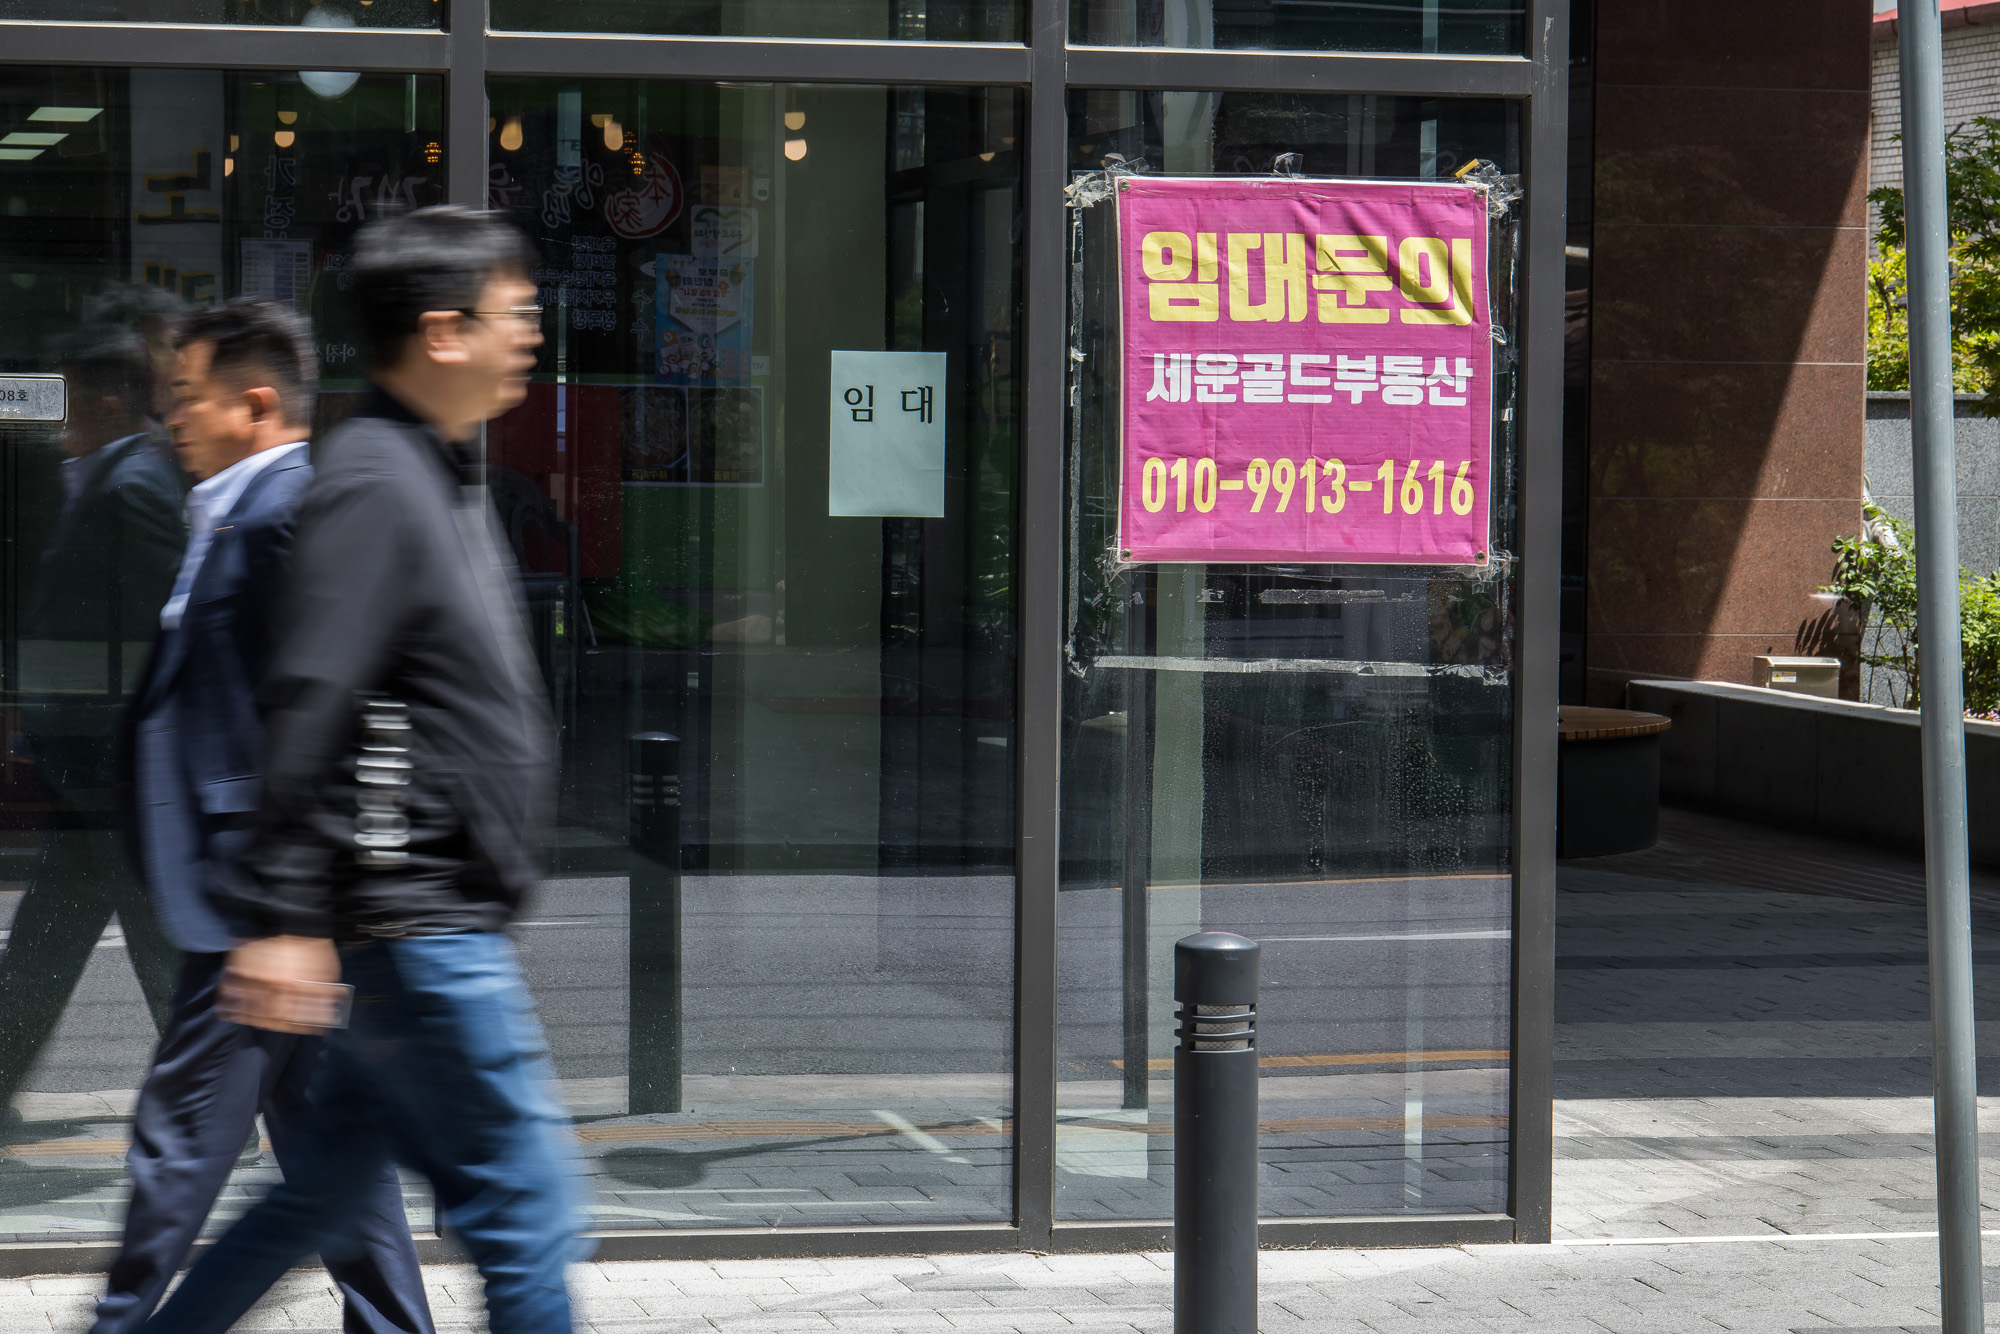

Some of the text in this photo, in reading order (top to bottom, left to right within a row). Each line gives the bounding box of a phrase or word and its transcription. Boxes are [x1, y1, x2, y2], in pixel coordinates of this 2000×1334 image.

[1142, 231, 1473, 326] 임대문의
[1146, 353, 1474, 406] 세운골드부동산
[1142, 456, 1475, 515] 010-9913-1616
